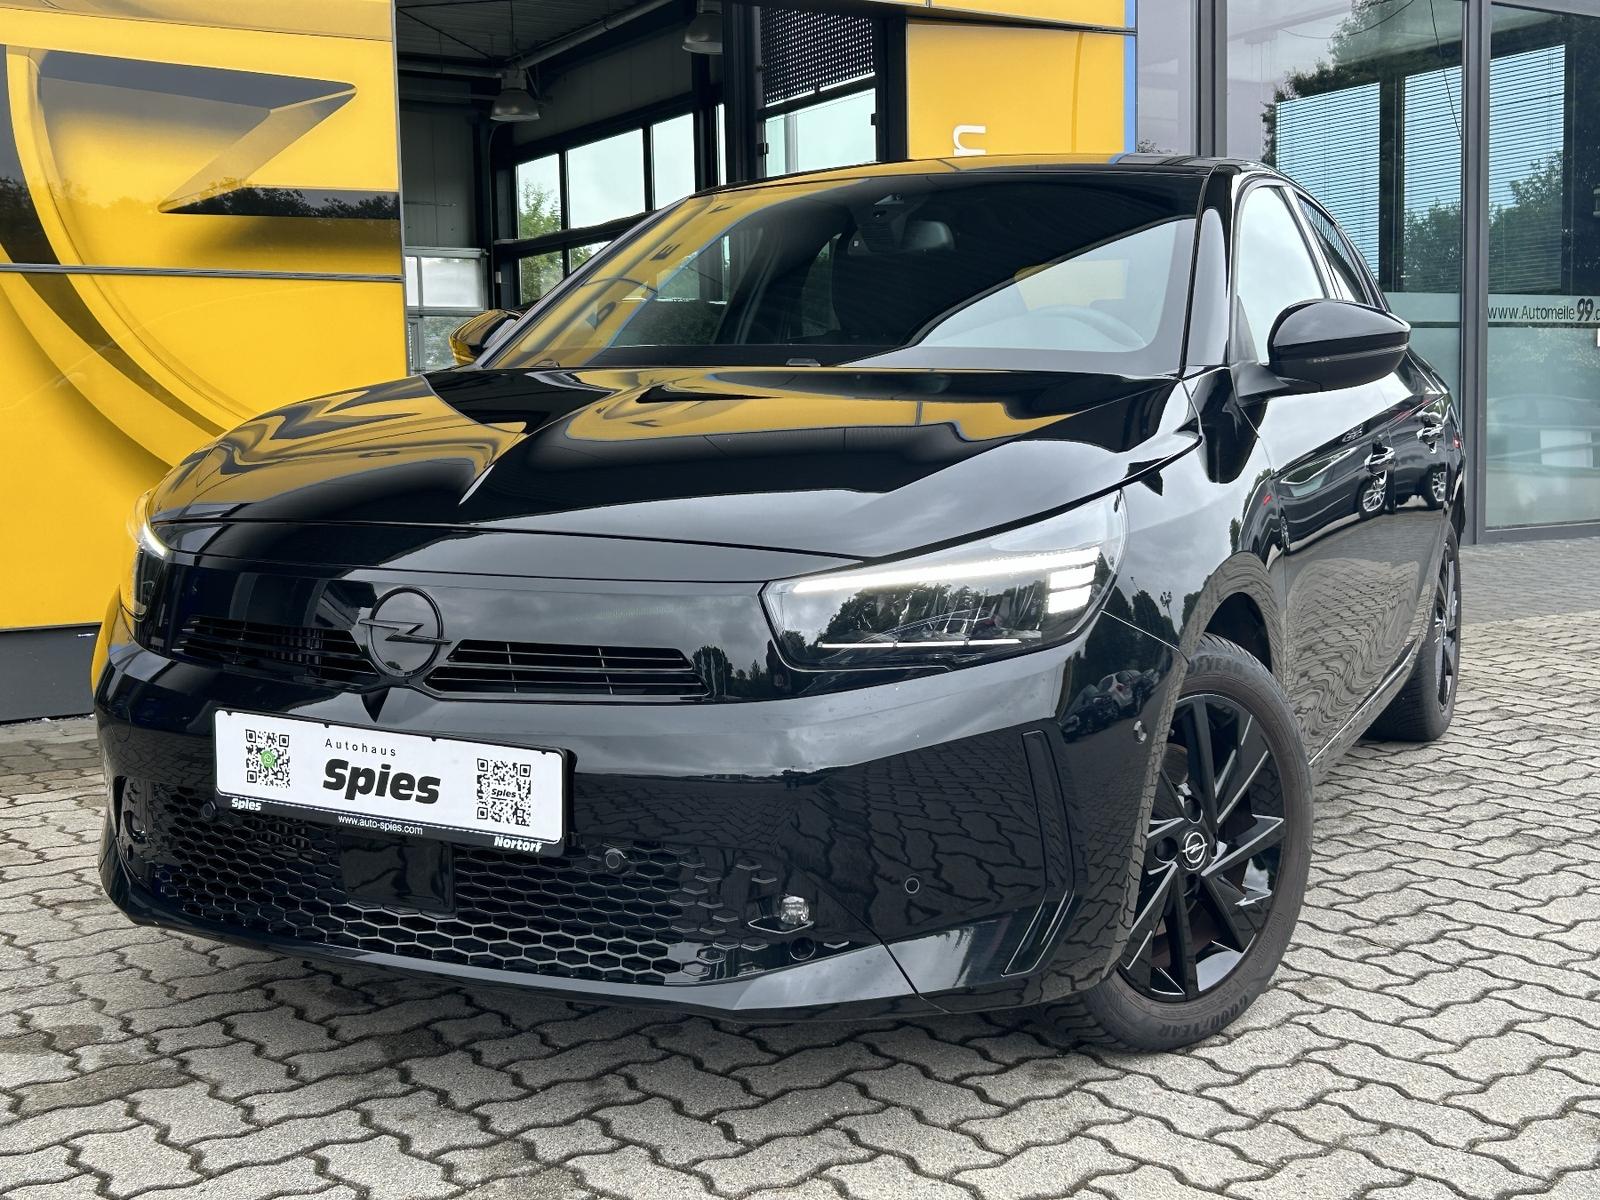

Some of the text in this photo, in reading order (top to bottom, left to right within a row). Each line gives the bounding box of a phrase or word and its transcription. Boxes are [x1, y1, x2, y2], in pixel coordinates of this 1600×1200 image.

[324, 738, 397, 757] Autohaus
[322, 758, 441, 804] Spies
[490, 786, 517, 799] Spies
[231, 798, 262, 812] Spies
[338, 814, 423, 836] www.auto-spies.com
[494, 836, 543, 853] Nortorf
